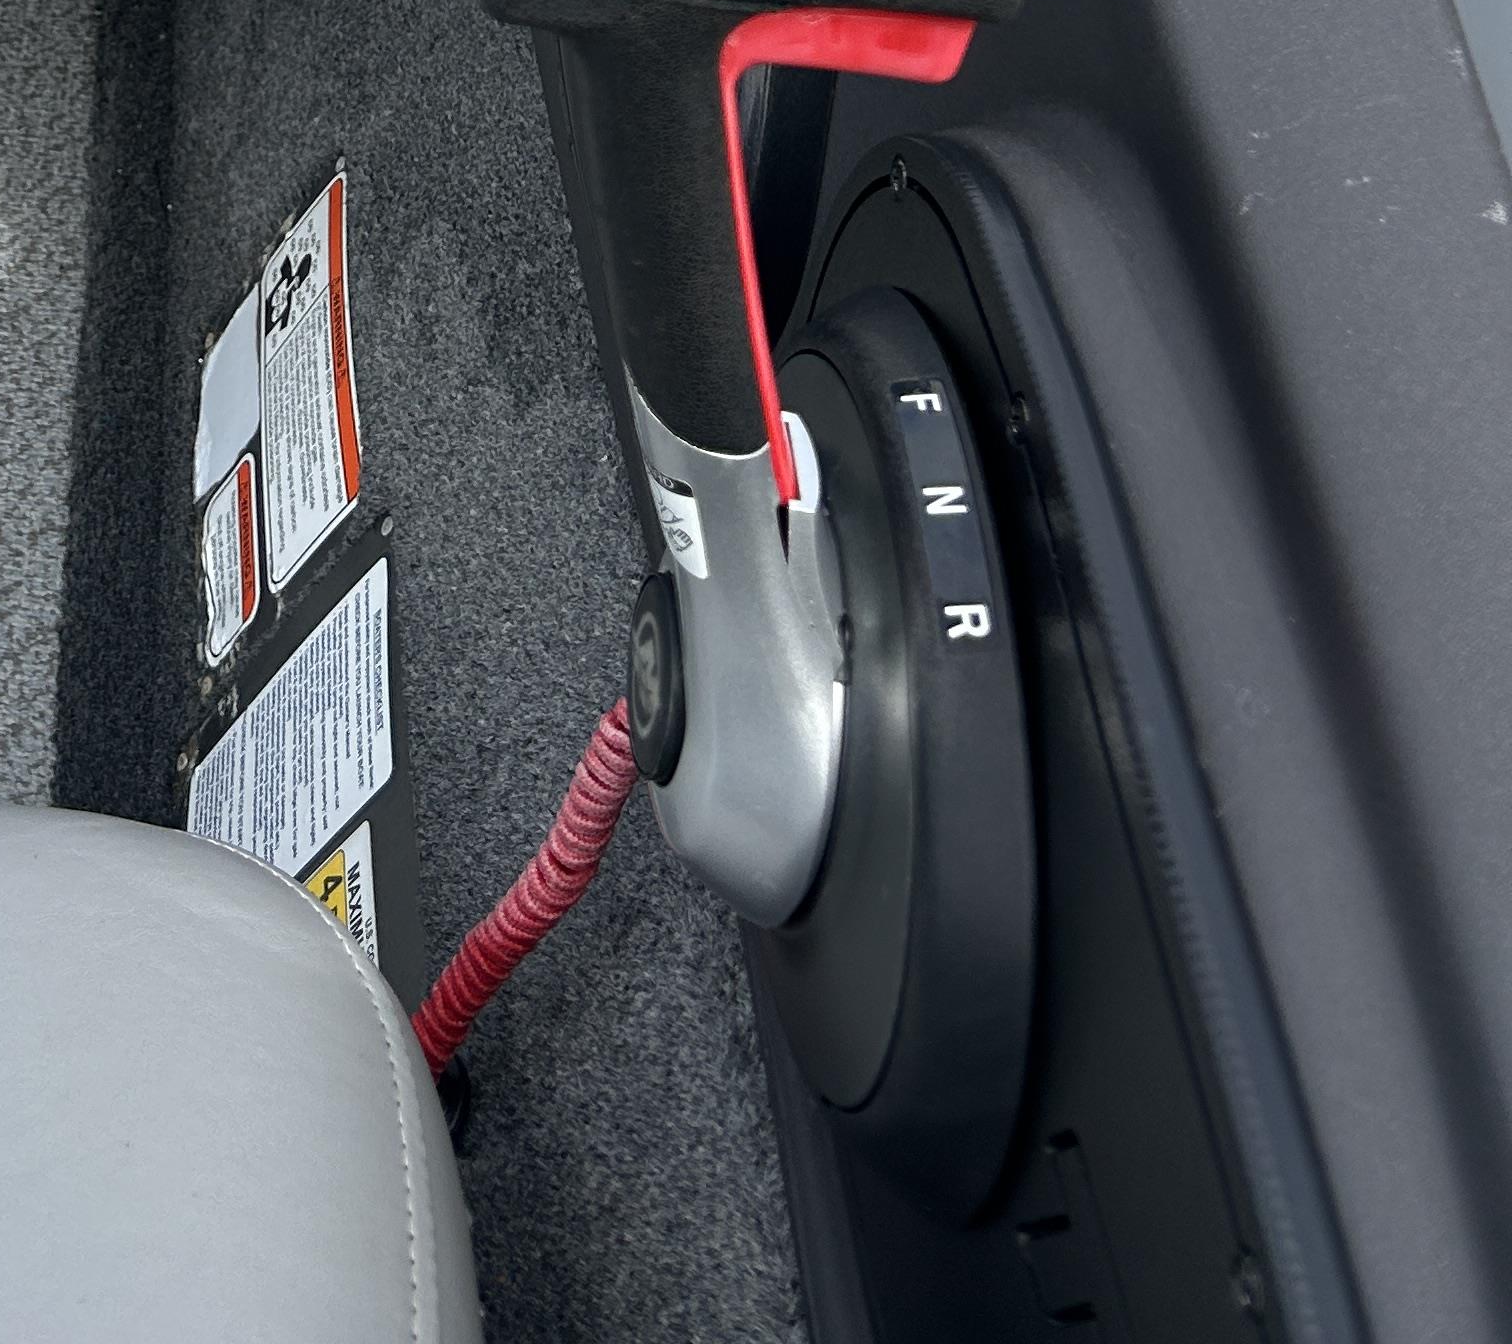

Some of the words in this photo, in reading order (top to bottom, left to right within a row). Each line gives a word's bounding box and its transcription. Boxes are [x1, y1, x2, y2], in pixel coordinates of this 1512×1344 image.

[333, 286, 344, 371] WARNING
[899, 393, 942, 412] F
[921, 485, 968, 515] N
[943, 603, 992, 639] R
[320, 875, 343, 903] 4
[347, 860, 364, 946] MAXIM
